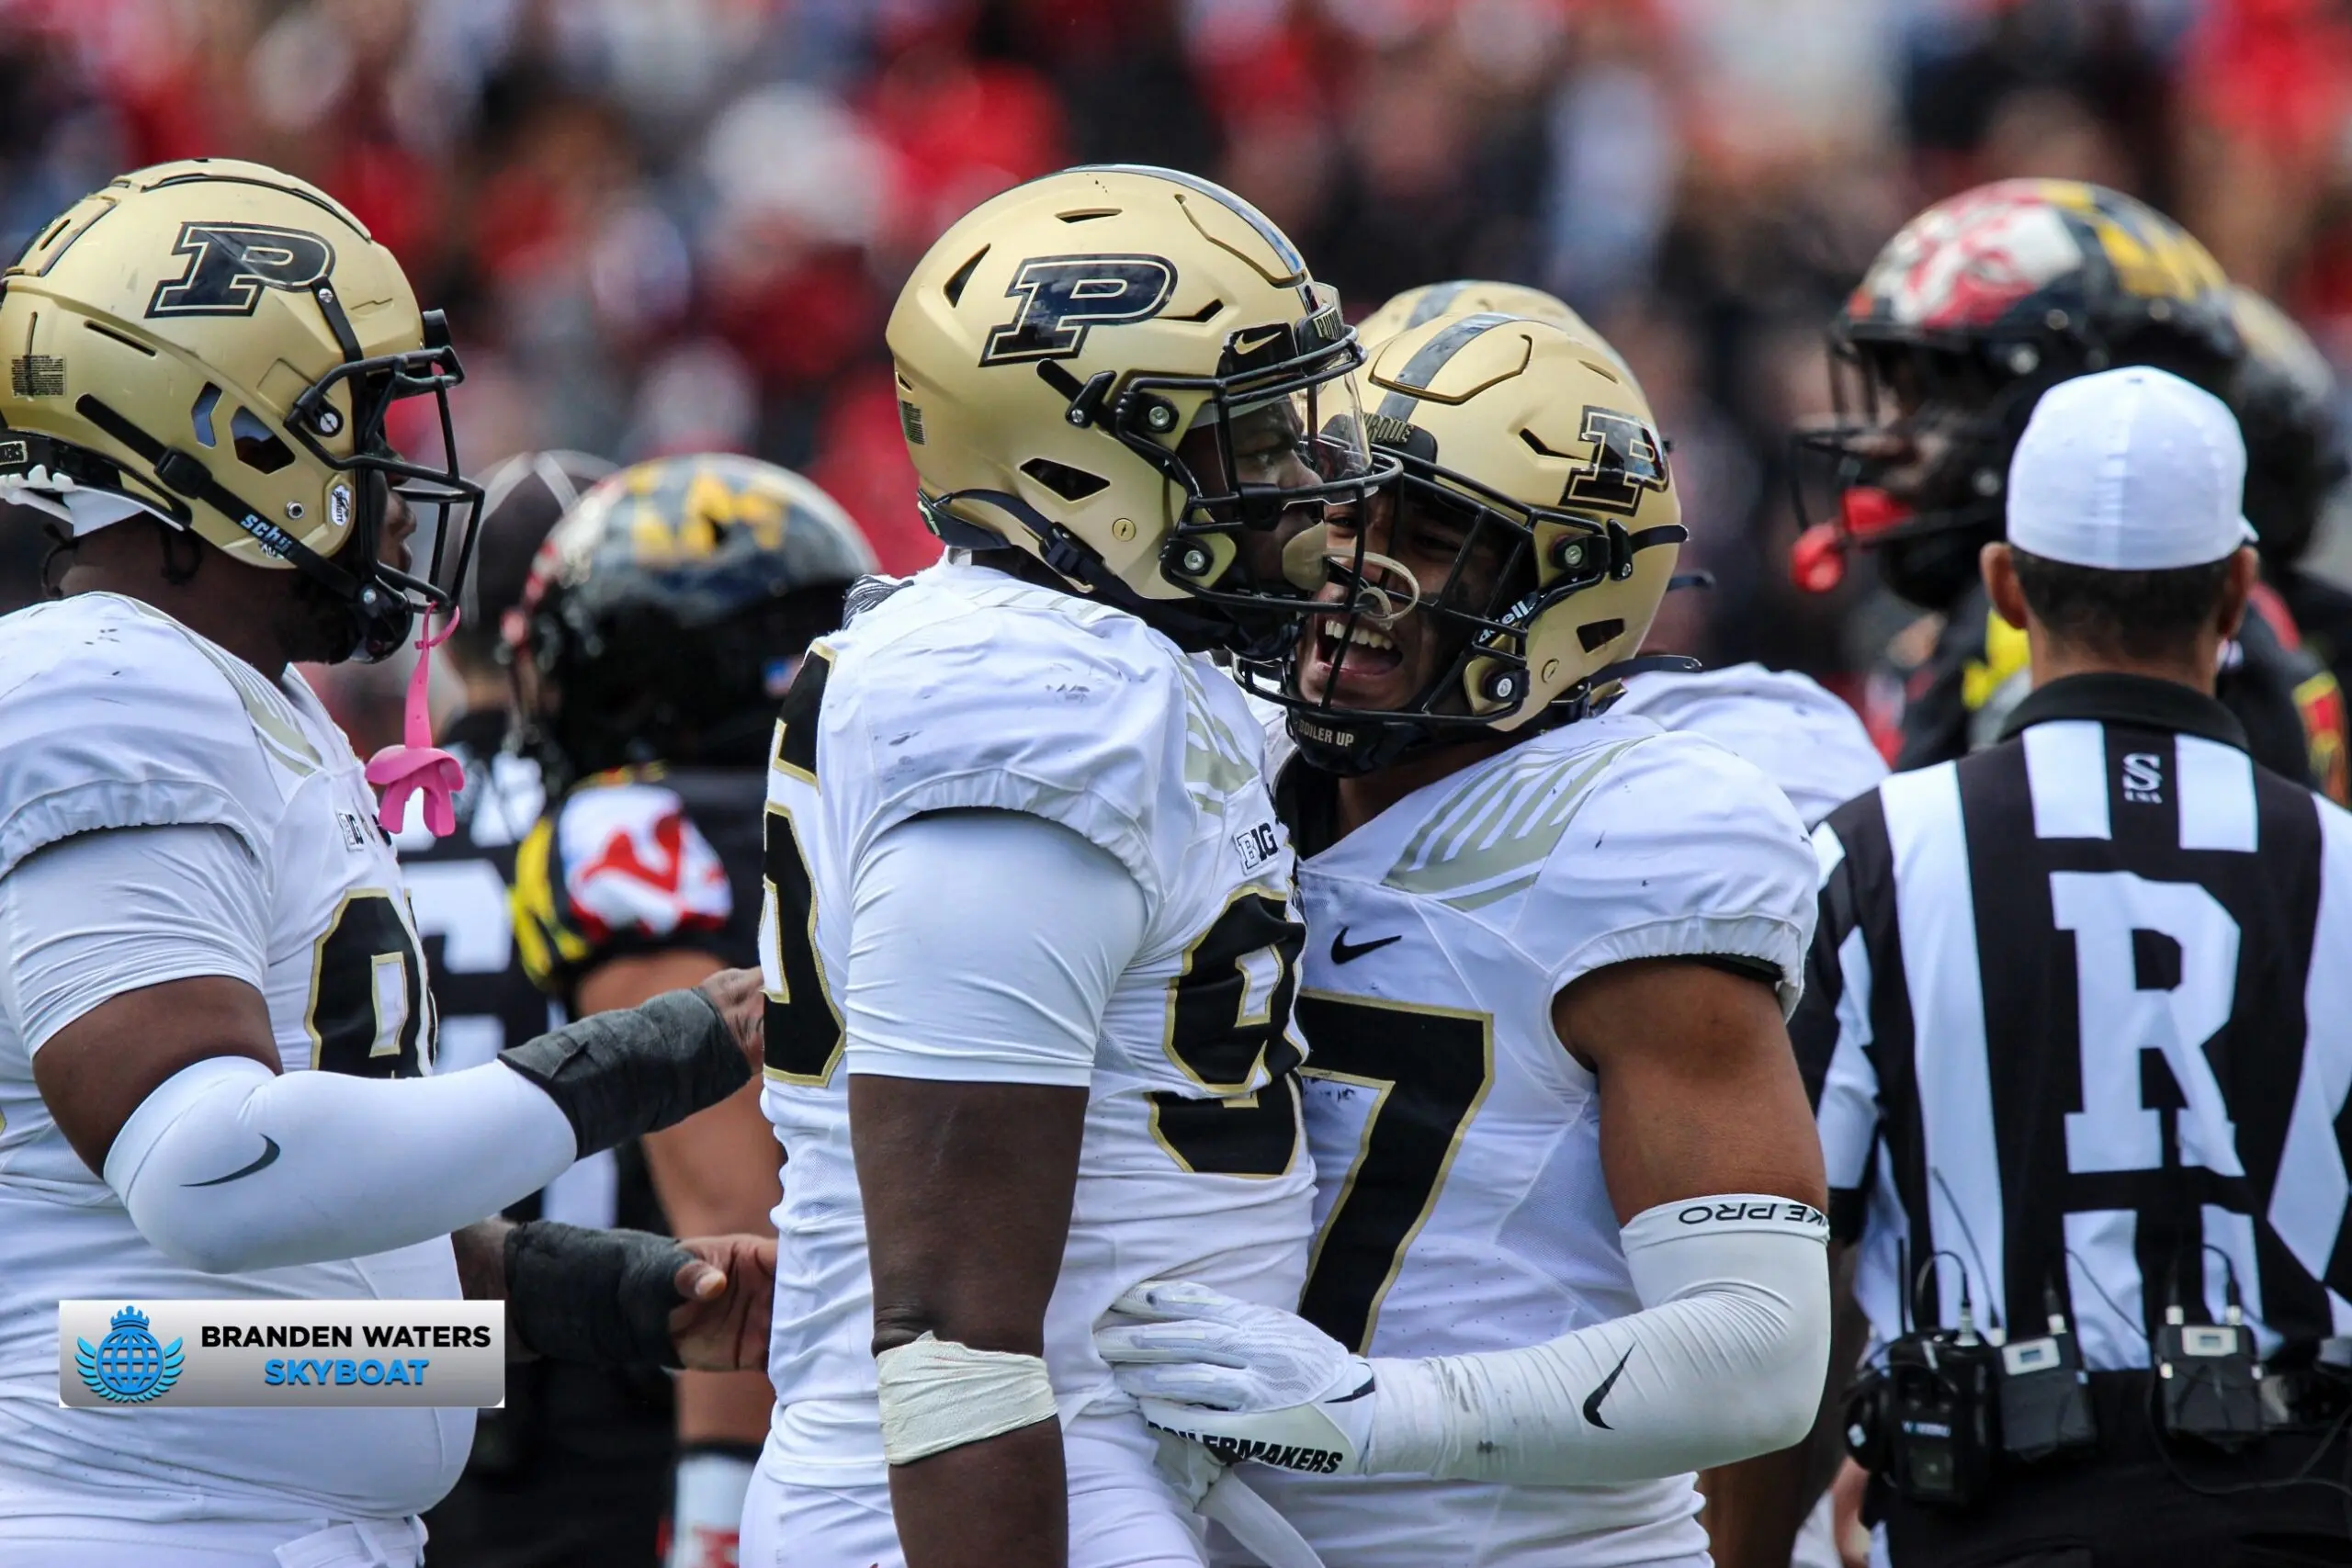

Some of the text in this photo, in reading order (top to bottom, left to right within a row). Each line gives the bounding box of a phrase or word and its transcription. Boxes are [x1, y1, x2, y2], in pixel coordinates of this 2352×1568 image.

[144, 221, 336, 319] P
[978, 254, 1179, 367] P
[1559, 405, 1670, 515] P
[1298, 718, 1355, 747] BOILER UP
[2049, 870, 2247, 1179] R
[1679, 1202, 1778, 1224] PRO
